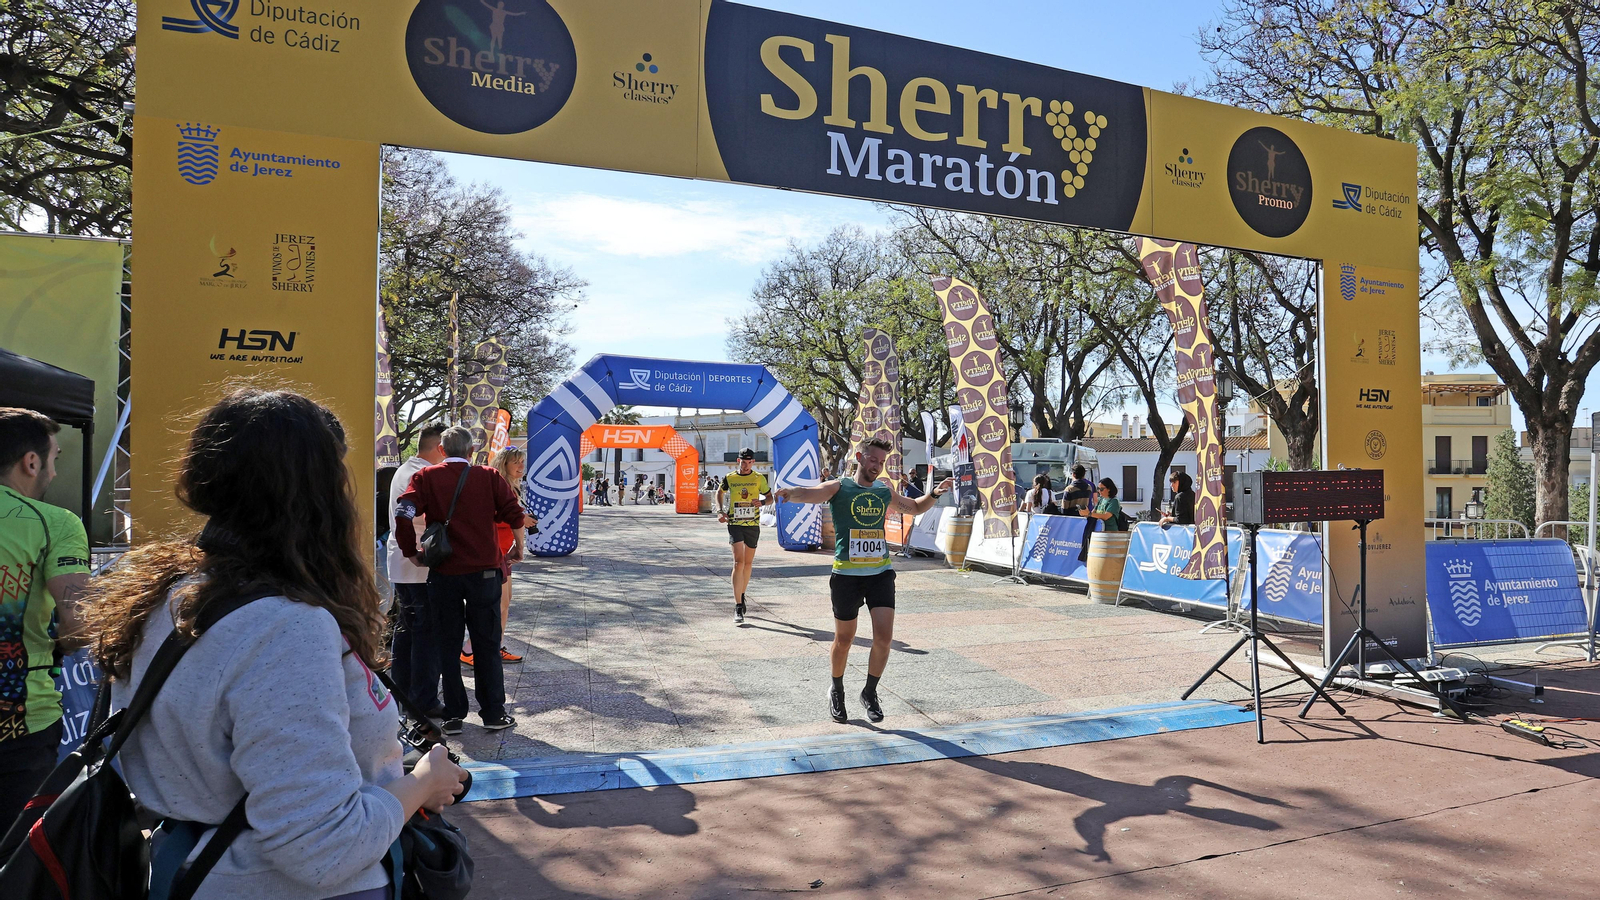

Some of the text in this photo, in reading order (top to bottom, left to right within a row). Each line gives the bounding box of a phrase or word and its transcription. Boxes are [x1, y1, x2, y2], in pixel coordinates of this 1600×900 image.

[250, 0, 360, 30] Diputación
[250, 25, 340, 53] de Cádiz
[423, 36, 560, 93] Sherry
[471, 71, 536, 95] Media
[612, 71, 679, 99] Sherry
[623, 89, 669, 105] classics
[759, 33, 1108, 199] Sherry
[230, 147, 341, 169] Ayuntamiento
[230, 162, 293, 178] de Jerez
[826, 130, 1059, 205] Maratón
[1164, 162, 1206, 183] Sherry
[1236, 171, 1304, 208] Sherry
[1365, 186, 1410, 205] Diputación
[1258, 194, 1293, 210] Promo
[1365, 204, 1402, 219] de Cádiz
[273, 234, 315, 245] JEREZ
[272, 253, 282, 276] VINOS
[306, 251, 315, 283] WINES
[272, 282, 314, 293] SHERRY
[1360, 276, 1404, 290] Ayuntamiento
[1360, 285, 1385, 295] de Jerez
[218, 328, 297, 351] HSN
[251, 355, 303, 364] NUTRITION!
[654, 369, 752, 384] Diputación DEPORTES
[654, 382, 693, 393] de Cádiz
[1359, 388, 1390, 402] HSN
[471, 392, 493, 400] Sherry
[490, 416, 507, 452] HSN
[602, 429, 652, 444] HSN
[856, 506, 881, 514] Sherry
[856, 541, 881, 552] 1004
[1050, 538, 1083, 549] Ayuntamien
[1055, 547, 1069, 556] Jerez
[1170, 564, 1181, 576] de
[1295, 580, 1308, 591] de
[1485, 577, 1559, 594] Ayuntamiento
[1487, 594, 1530, 608] de Jerez
